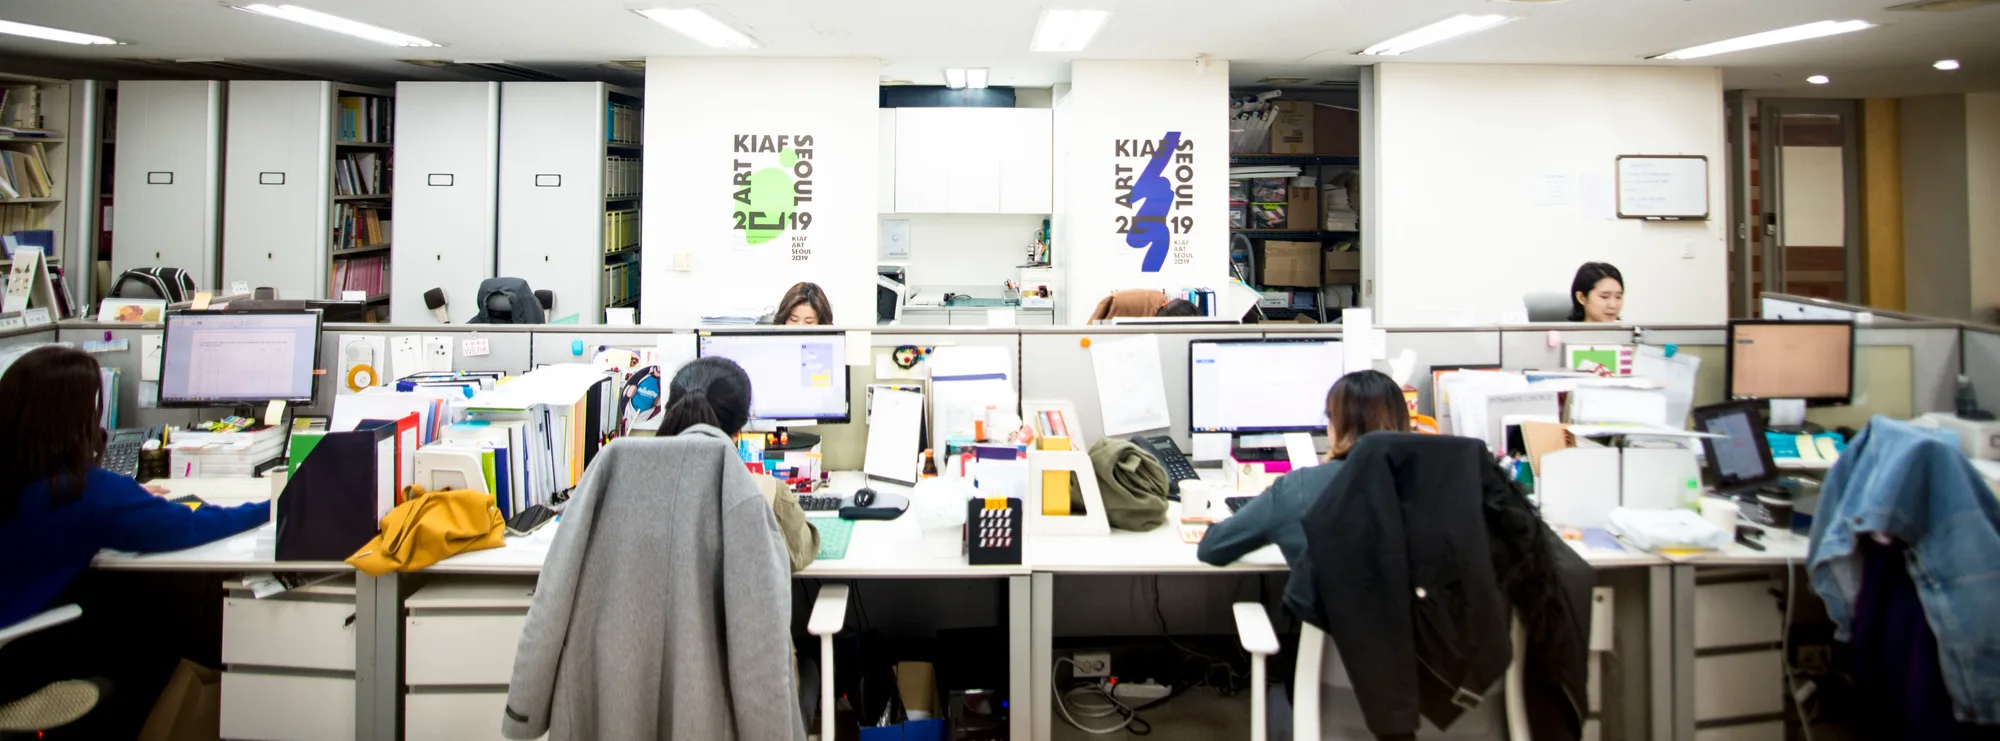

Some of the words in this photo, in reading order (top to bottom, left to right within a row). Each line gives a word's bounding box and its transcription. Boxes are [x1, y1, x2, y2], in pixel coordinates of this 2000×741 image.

[734, 135, 789, 153] KIAF
[1115, 139, 1170, 158] KIAF
[733, 159, 751, 205] ART
[794, 135, 813, 206] SEOUL
[1115, 164, 1133, 209] ART
[1175, 139, 1193, 210] SEOUL
